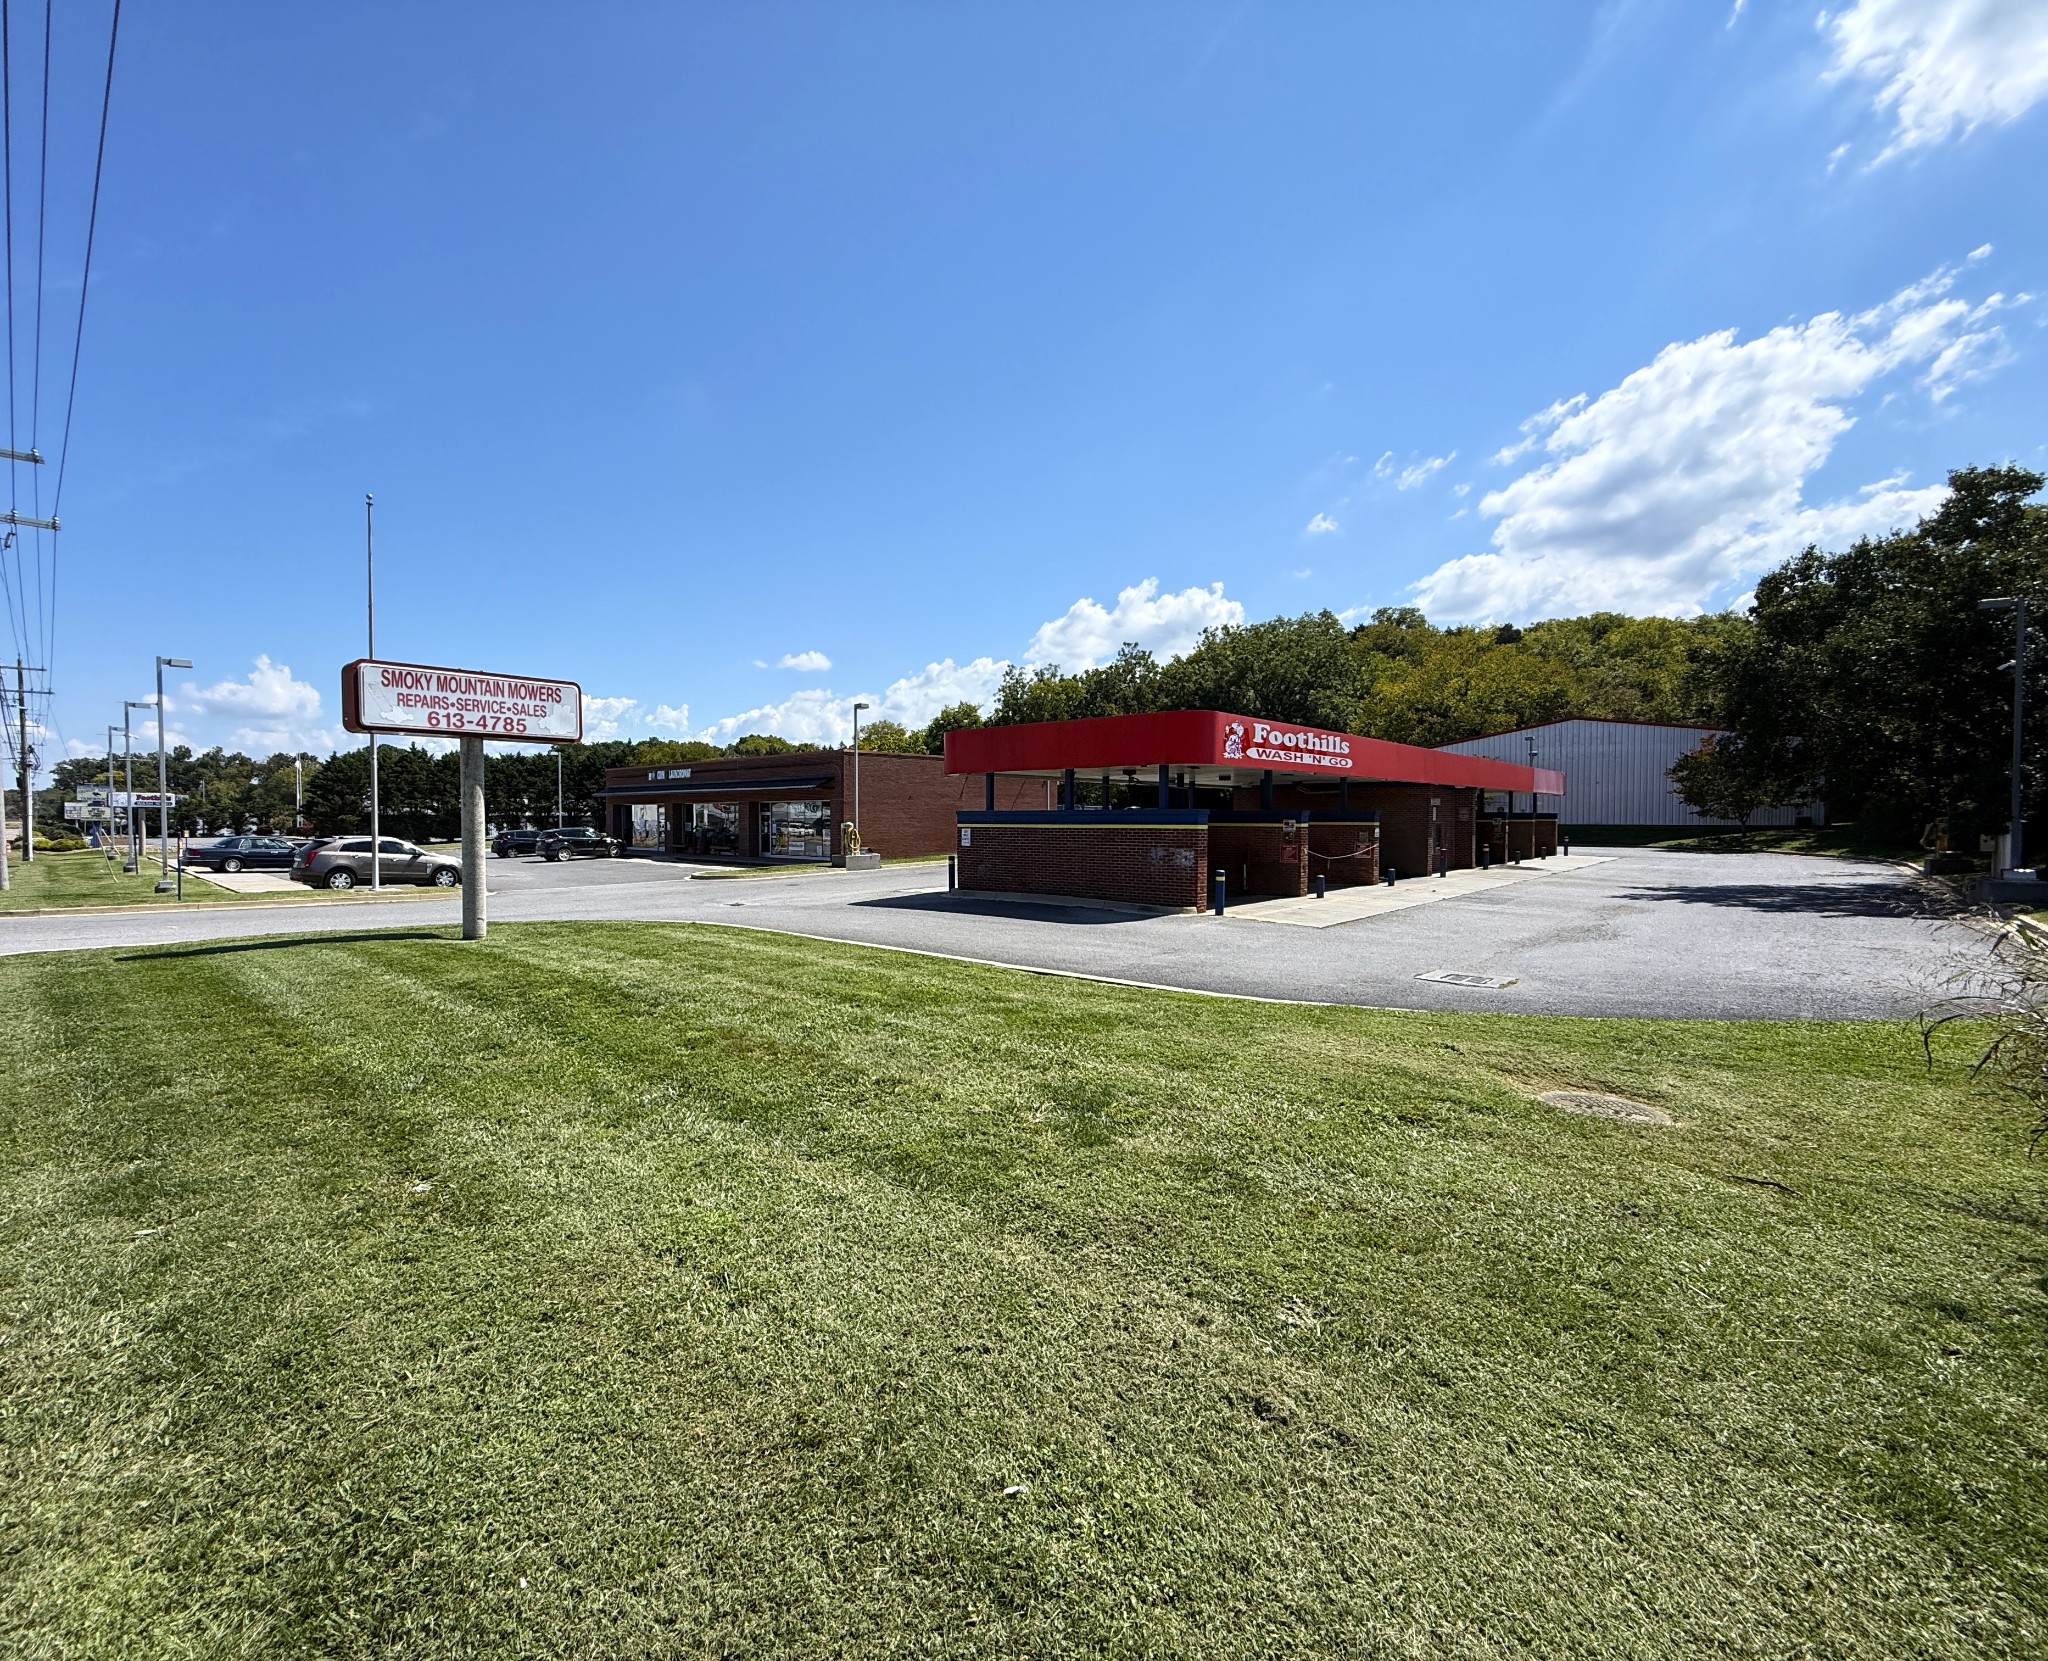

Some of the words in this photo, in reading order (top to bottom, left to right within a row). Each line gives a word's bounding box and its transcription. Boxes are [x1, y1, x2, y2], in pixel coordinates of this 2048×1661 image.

[381, 669, 432, 692] SMOKY
[436, 675, 505, 699] MOUNTAIN
[507, 683, 562, 704] MOWERS
[427, 711, 527, 733] 613-4785
[1253, 723, 1350, 754] Foothills
[1256, 748, 1304, 763] WASH
[1329, 757, 1349, 767] GO
